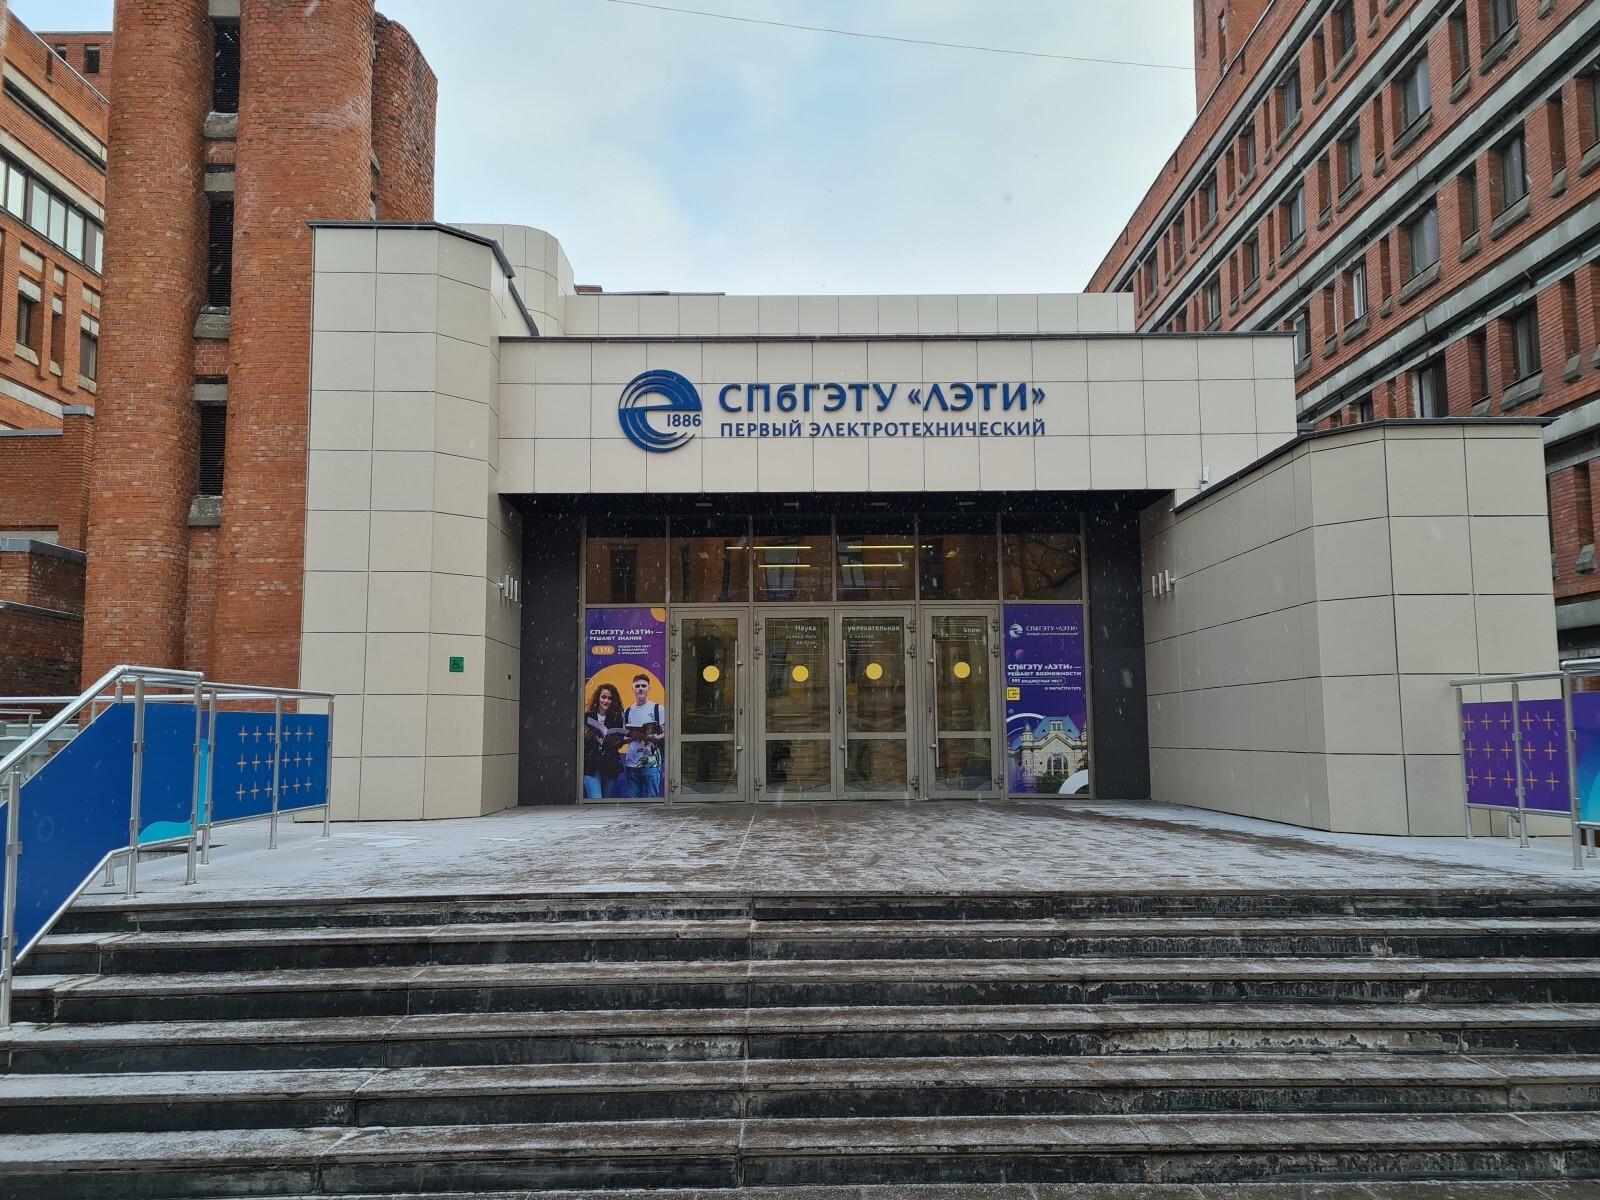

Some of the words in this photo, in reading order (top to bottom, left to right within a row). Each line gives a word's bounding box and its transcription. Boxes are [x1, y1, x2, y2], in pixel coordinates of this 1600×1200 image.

[719, 383, 897, 411] СПбГЭТУ
[908, 382, 1046, 411] «ЛЭТИ»
[667, 414, 702, 427] 1886
[720, 419, 802, 436] ПЕРВЫЙ
[809, 418, 1046, 436] ЭЛЕКТРОТЕХНИЧЕСКИЙ
[795, 624, 817, 632] Наука
